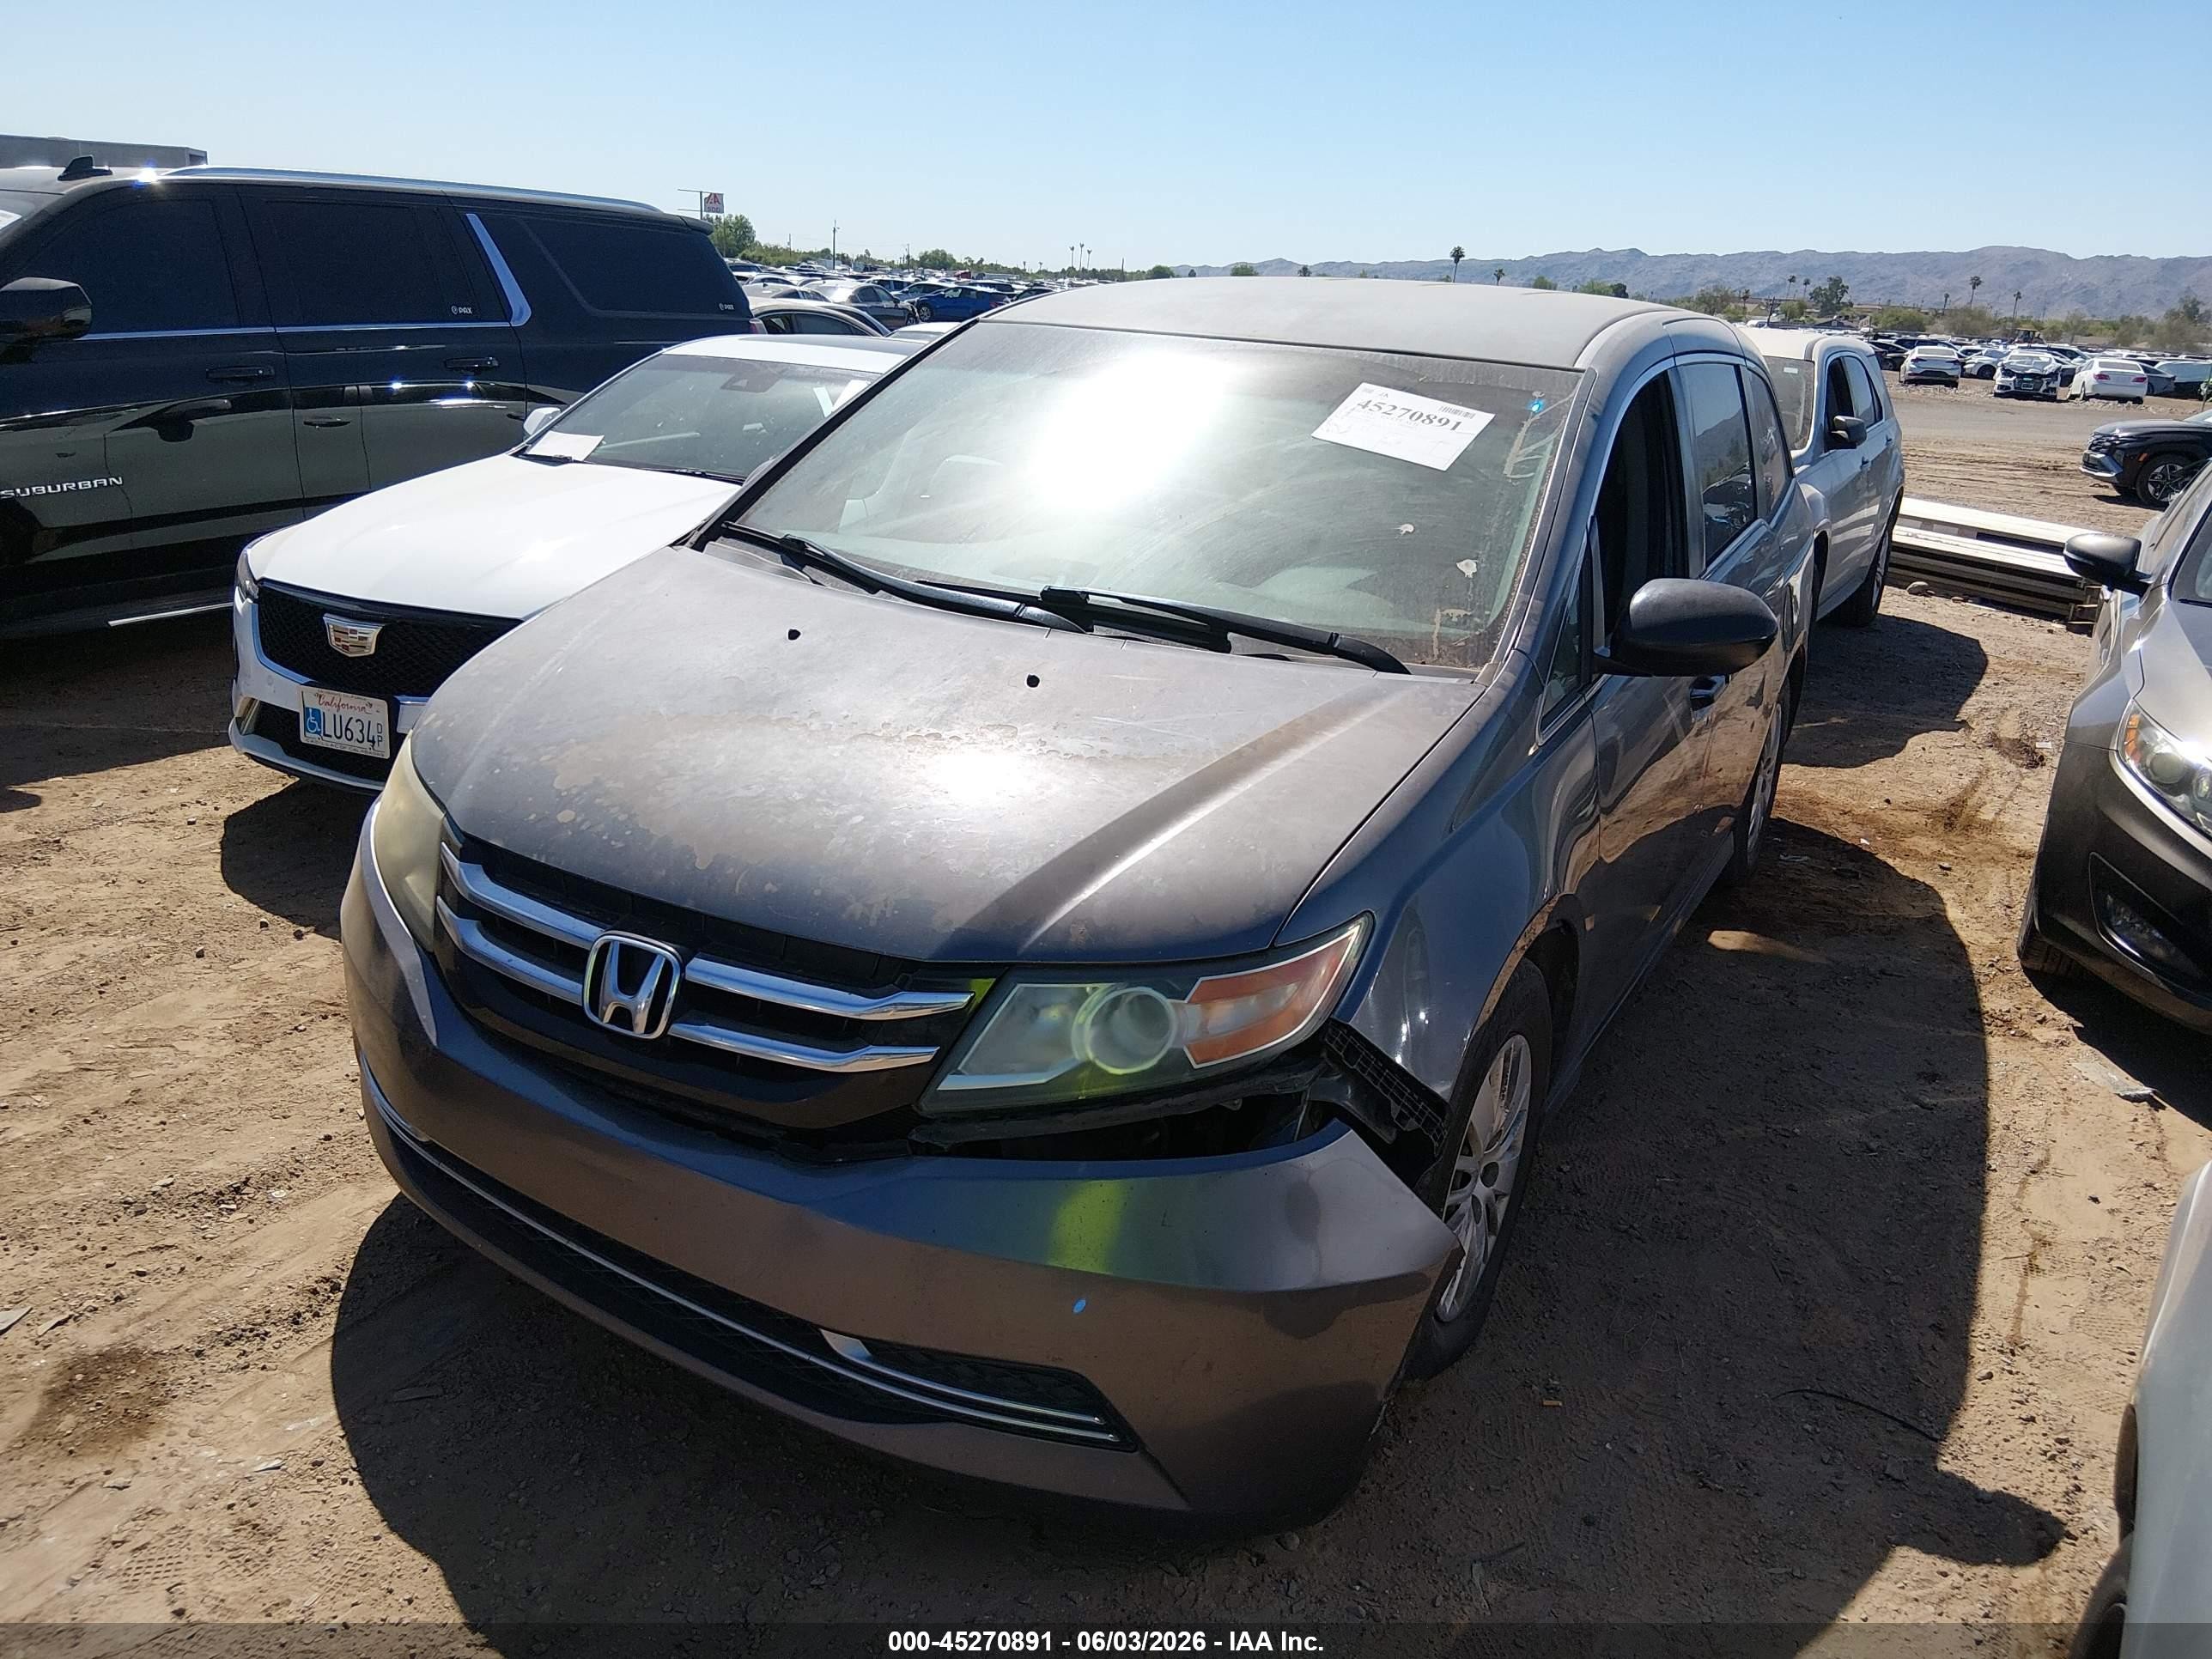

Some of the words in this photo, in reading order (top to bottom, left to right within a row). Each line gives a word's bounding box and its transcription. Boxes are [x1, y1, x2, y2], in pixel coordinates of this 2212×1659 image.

[1358, 399, 1463, 431] 45270891
[0, 477, 124, 499] SUBURBAN
[317, 694, 369, 714] California
[323, 711, 375, 745] LU634
